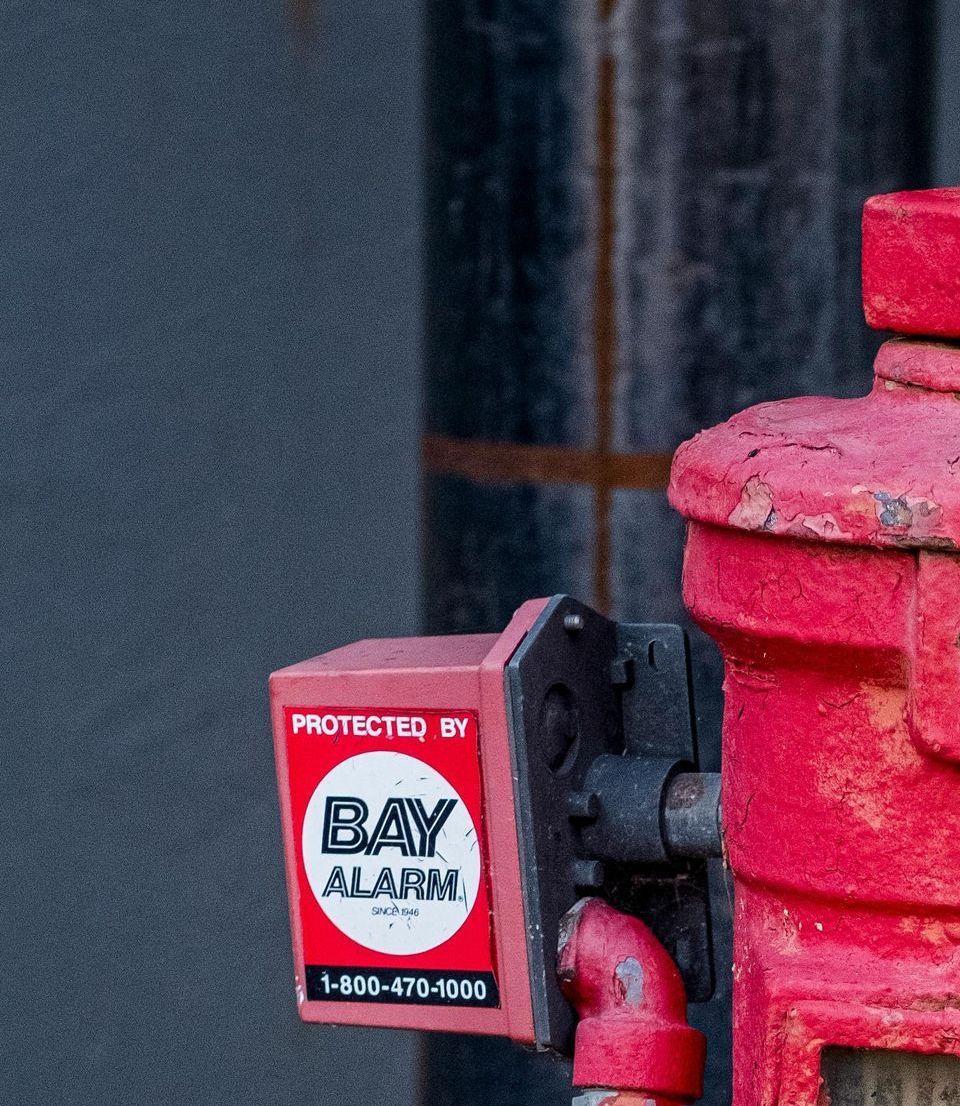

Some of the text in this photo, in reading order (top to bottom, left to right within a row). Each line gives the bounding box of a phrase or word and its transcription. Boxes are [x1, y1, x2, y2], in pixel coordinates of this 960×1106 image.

[291, 713, 469, 739] PROTECTED BY
[321, 796, 459, 858] BAY
[371, 906, 420, 917] SINCE 1946
[320, 974, 487, 1001] 1-800-470-1000
